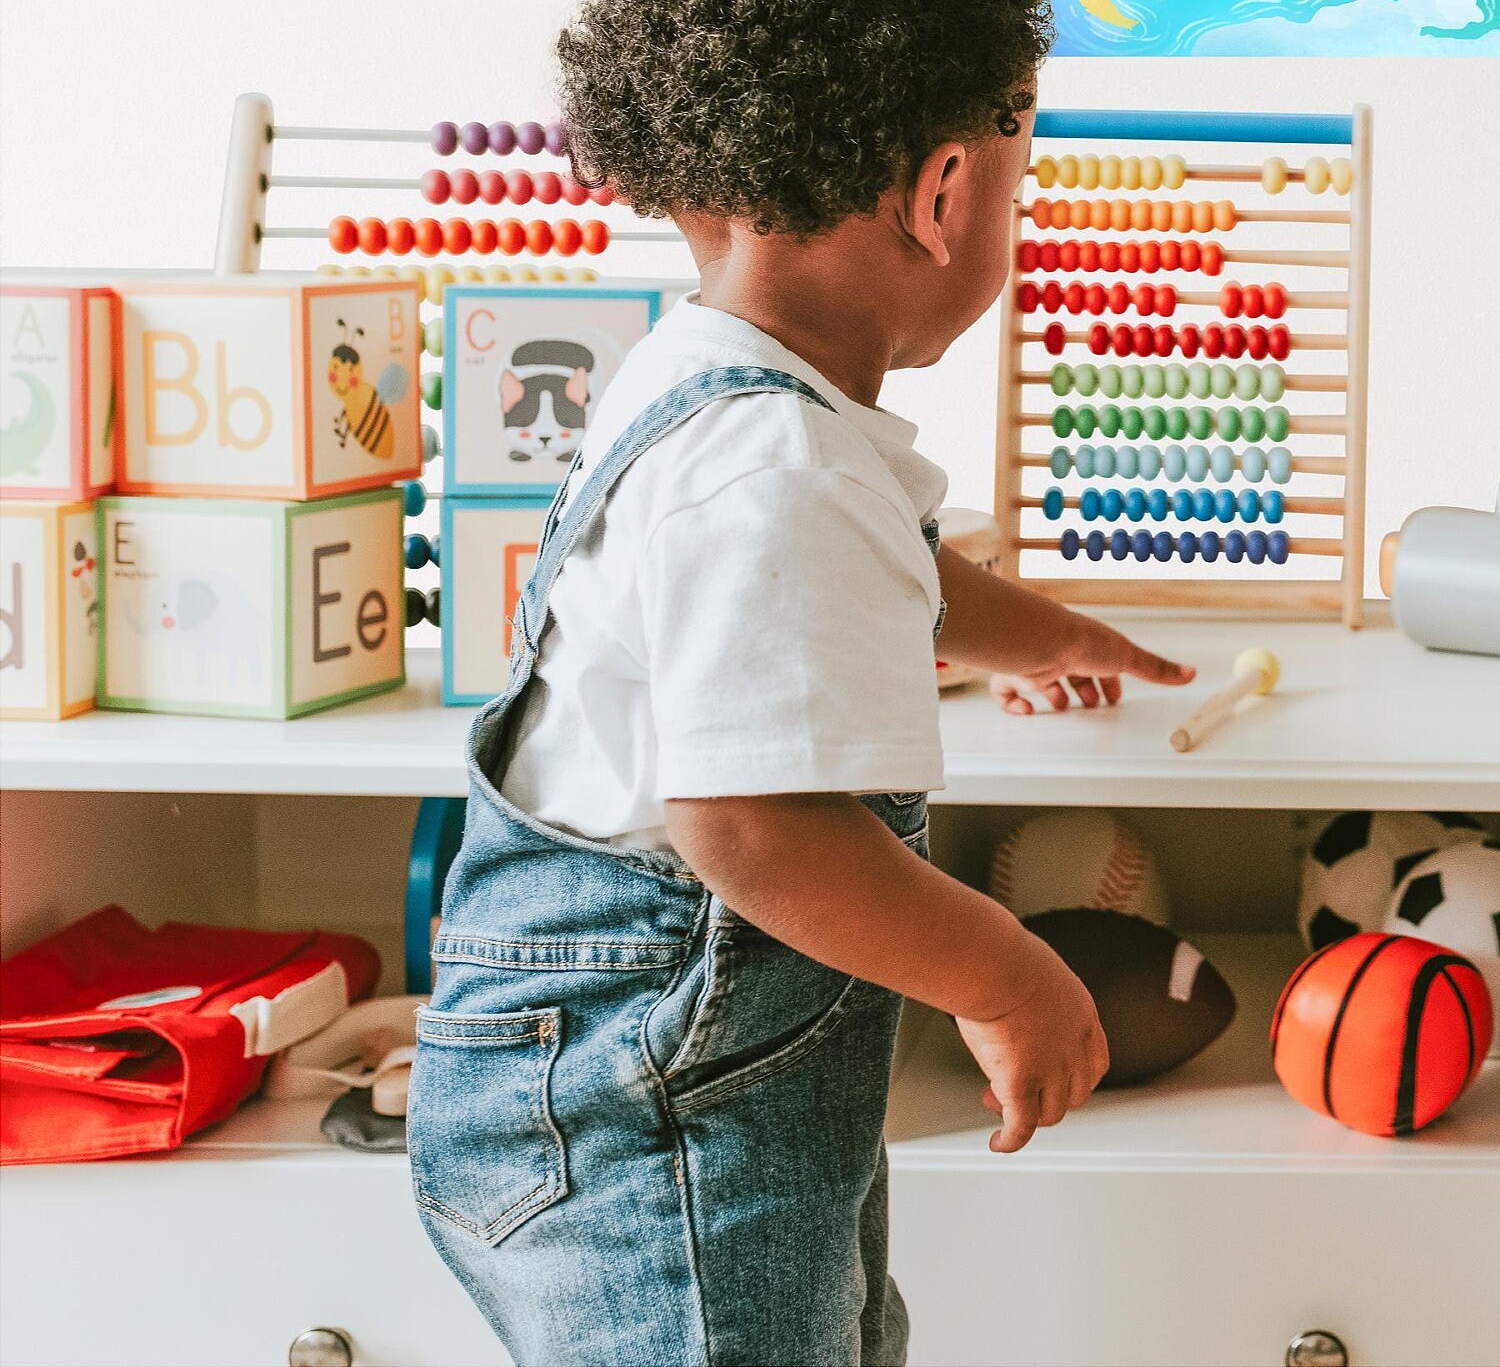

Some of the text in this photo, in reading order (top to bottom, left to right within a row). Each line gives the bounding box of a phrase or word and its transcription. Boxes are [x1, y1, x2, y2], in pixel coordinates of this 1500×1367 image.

[465, 308, 497, 352] C
[141, 330, 273, 451] Bb
[115, 521, 136, 565] E
[313, 542, 388, 663] Ee
